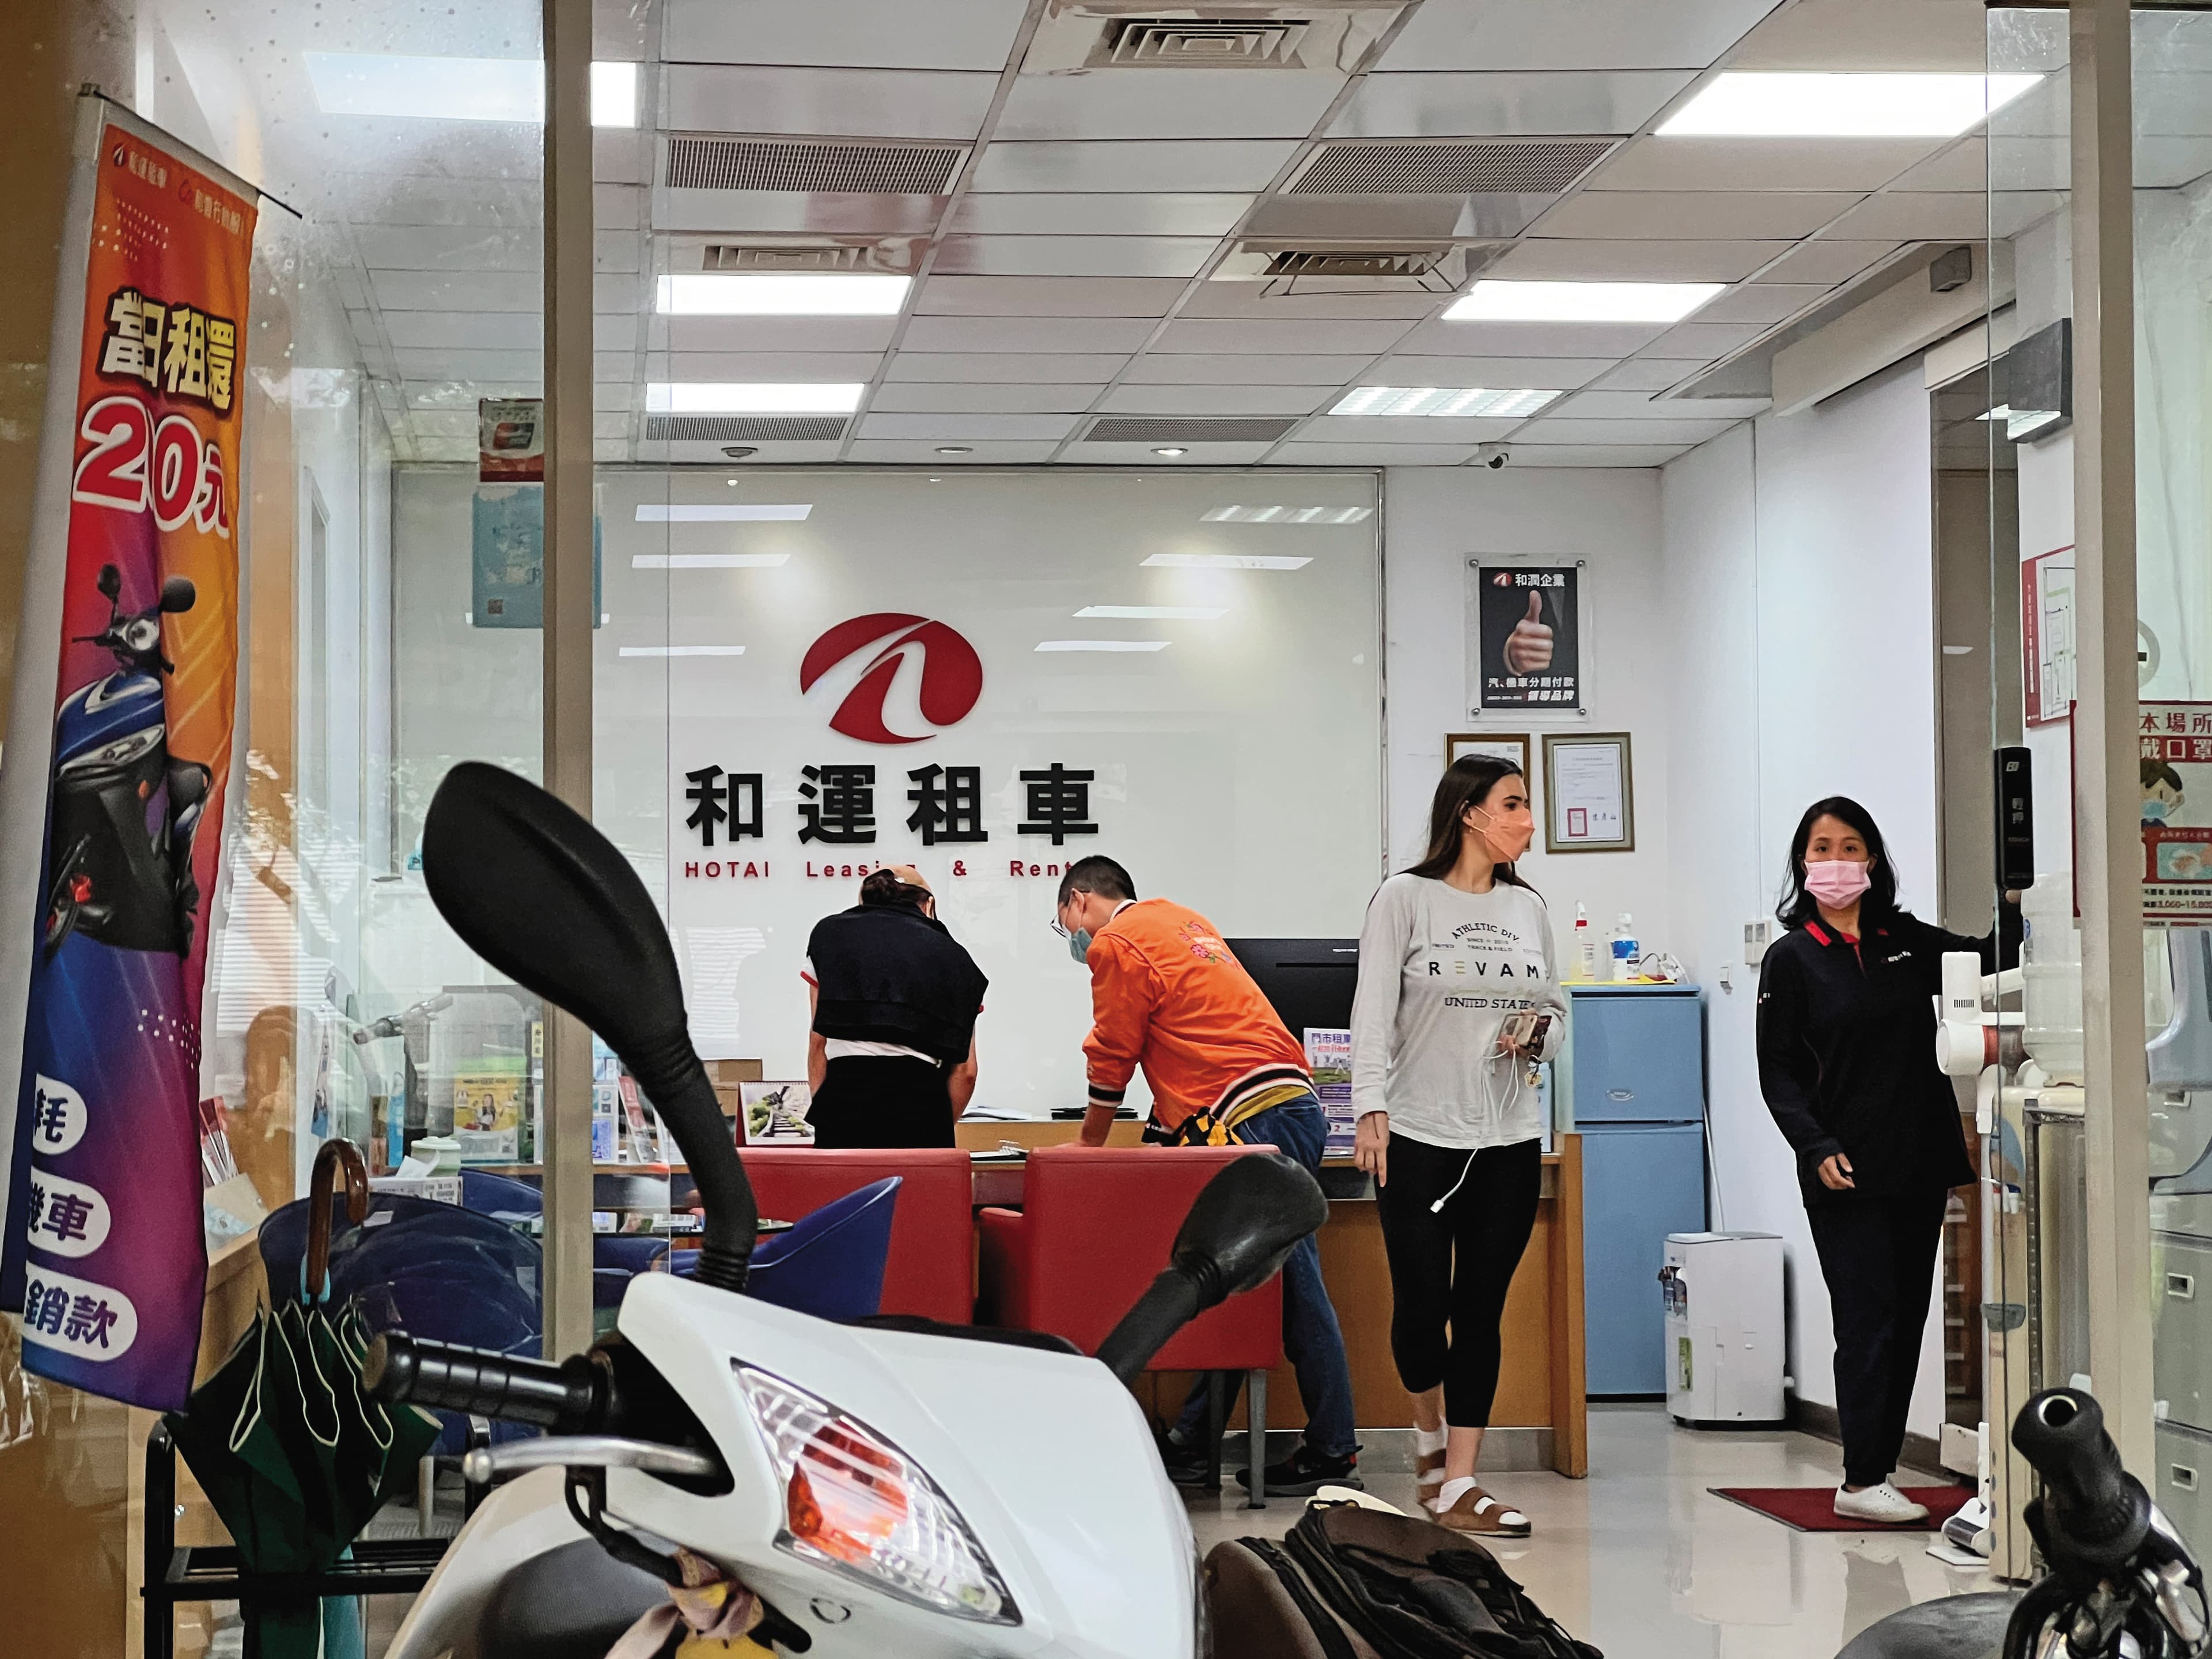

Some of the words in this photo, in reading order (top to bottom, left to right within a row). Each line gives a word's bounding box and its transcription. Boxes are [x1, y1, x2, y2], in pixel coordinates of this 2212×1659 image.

[1515, 574, 1565, 587] 和潤企業
[685, 763, 1099, 847] 和運租車
[685, 861, 770, 878] HOTAI
[806, 861, 916, 877] Leas
[953, 861, 968, 877] &
[1451, 922, 1498, 940] ATHLETIC
[1429, 960, 1549, 981] REVAM
[1445, 997, 1487, 1007] UNITED
[24, 1279, 118, 1349] 銷款
